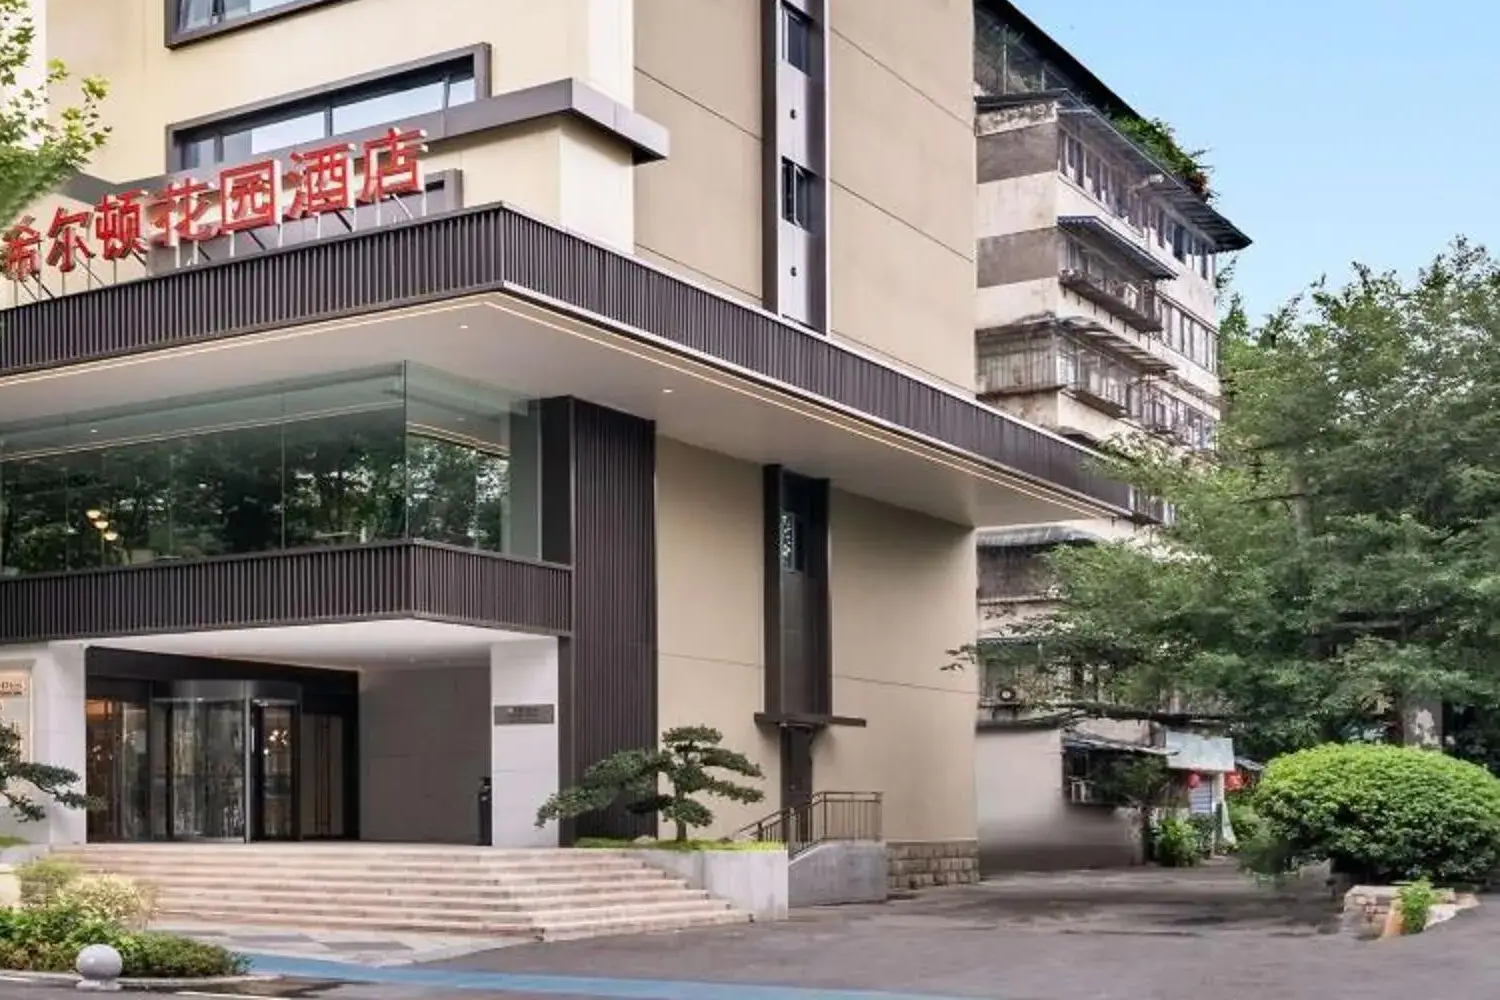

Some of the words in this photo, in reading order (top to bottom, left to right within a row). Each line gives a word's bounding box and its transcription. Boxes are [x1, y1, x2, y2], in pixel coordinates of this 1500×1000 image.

[3, 127, 426, 282] 希尔顿花园酒店
